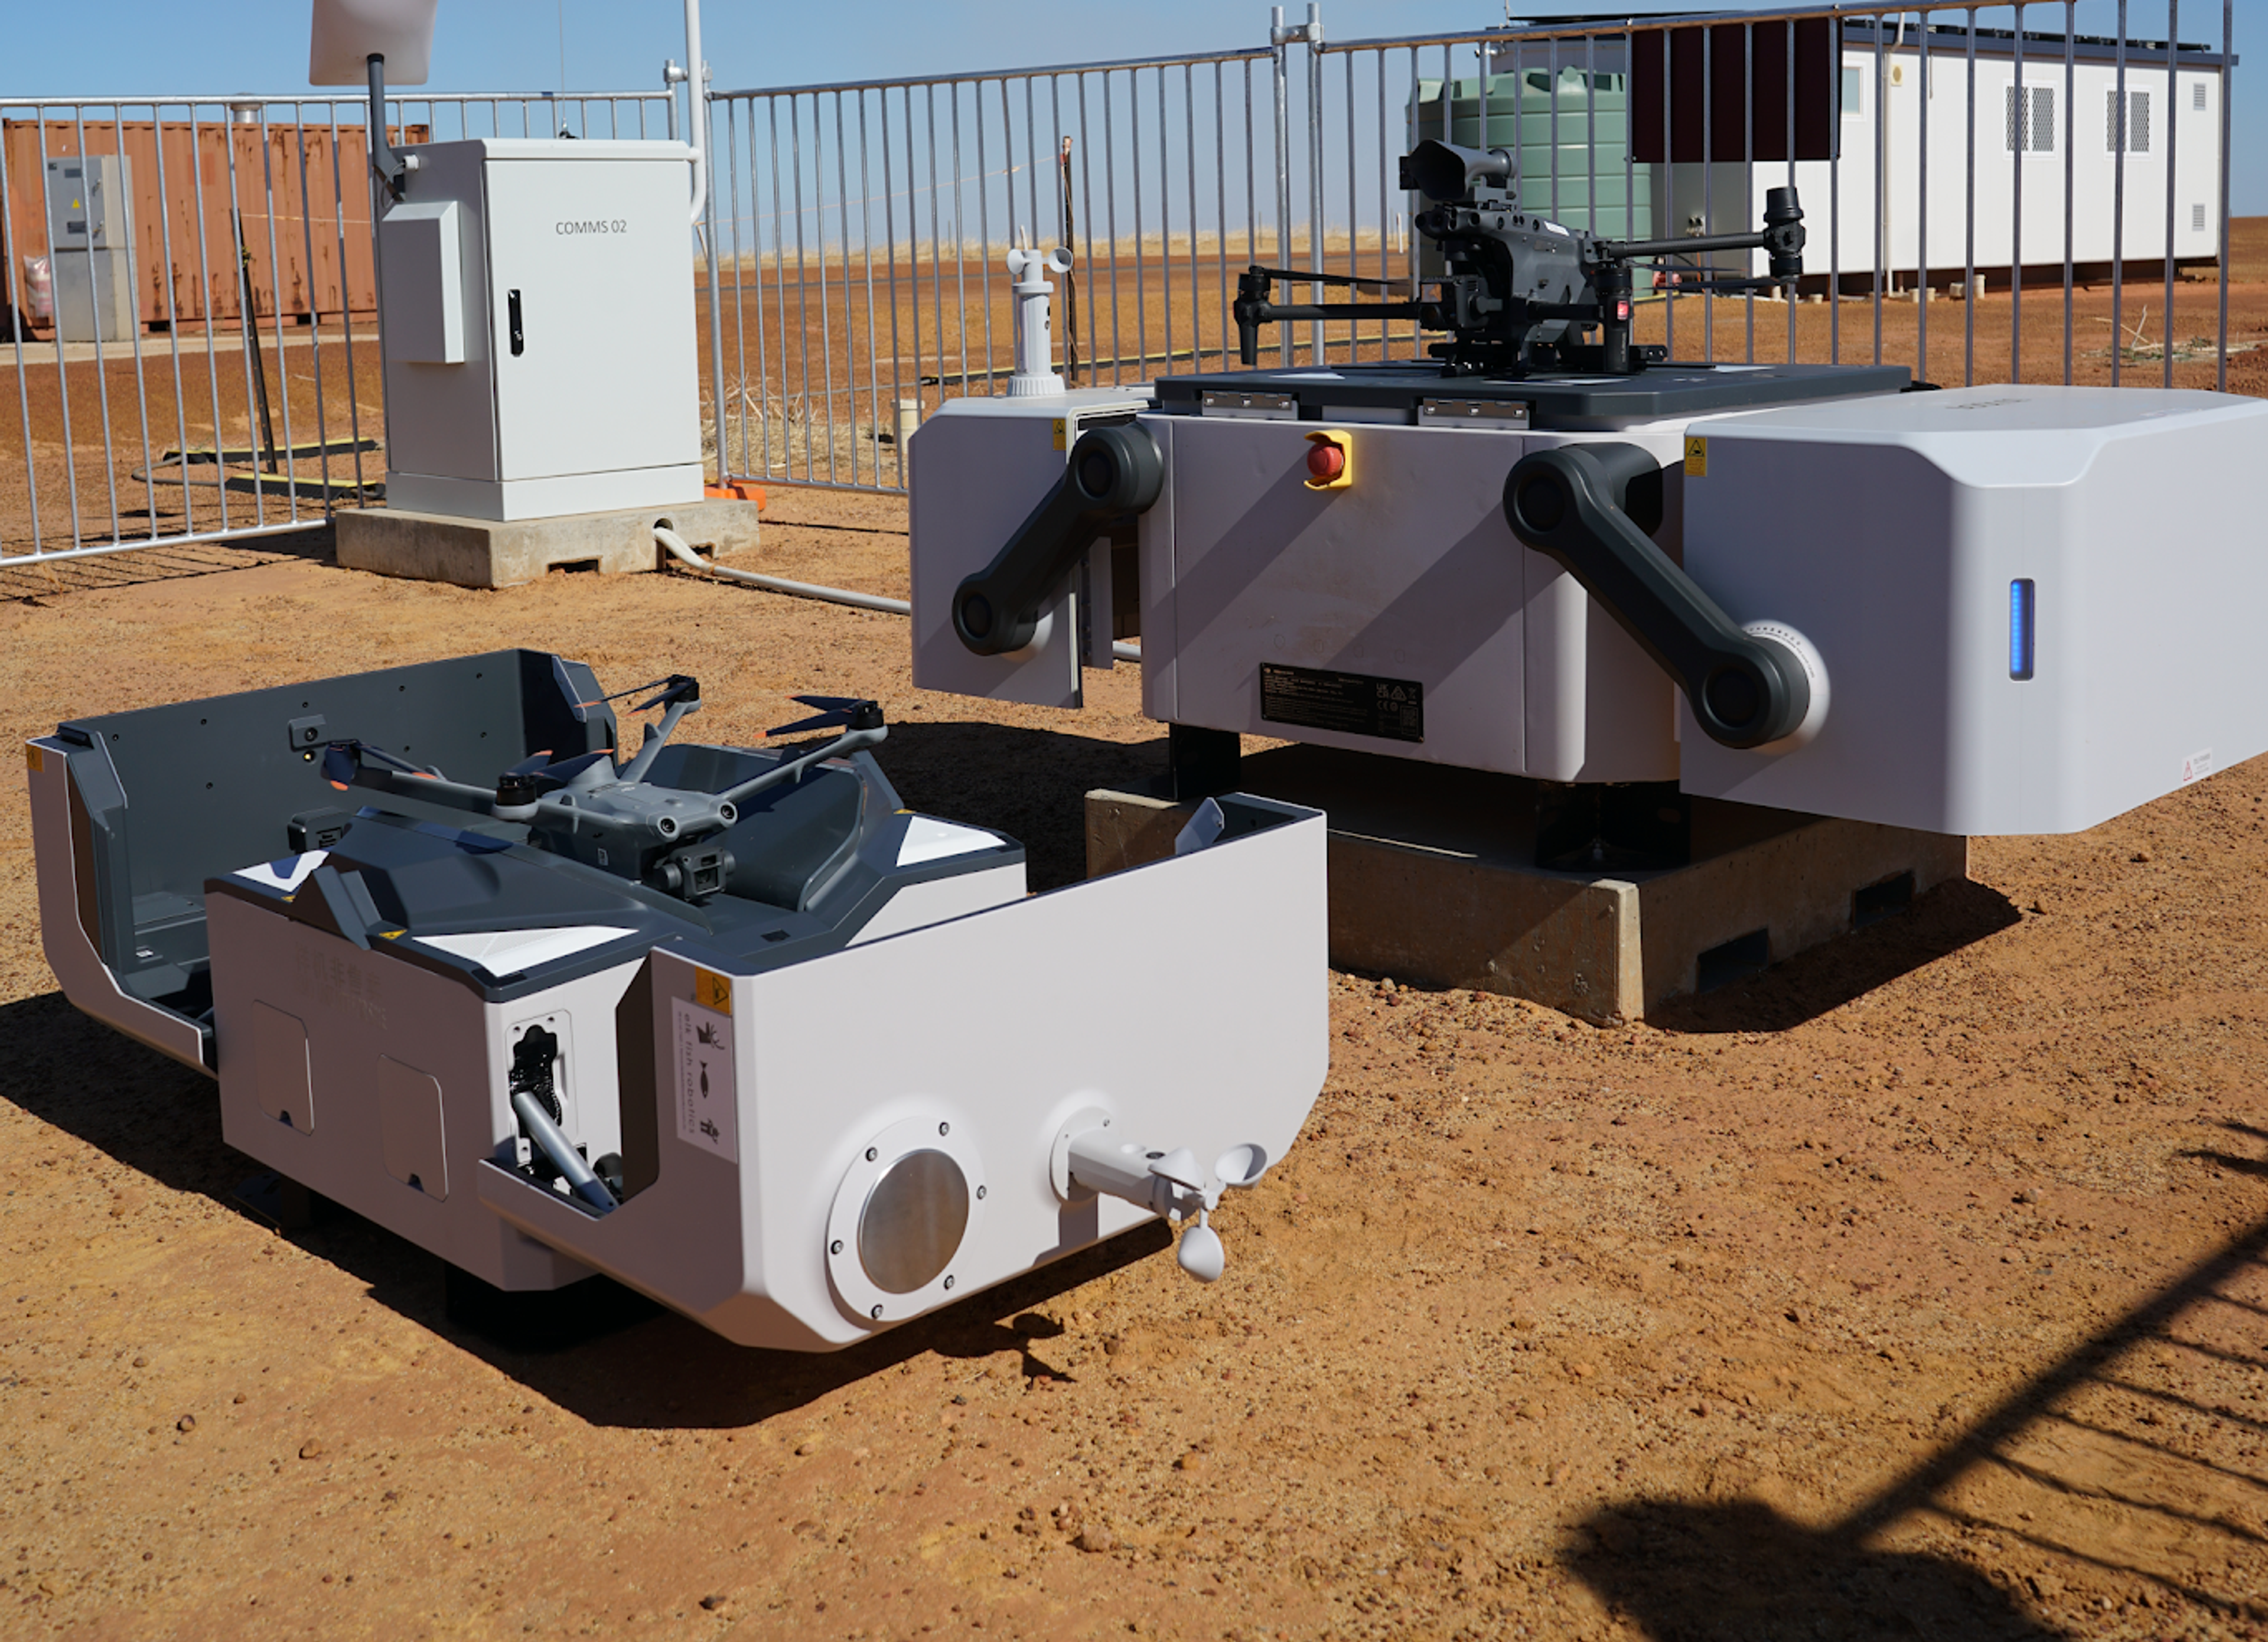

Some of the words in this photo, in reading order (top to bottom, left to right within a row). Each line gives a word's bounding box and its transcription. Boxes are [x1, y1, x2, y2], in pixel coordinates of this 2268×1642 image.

[556, 220, 608, 234] COMMS
[611, 220, 627, 233] 02
[687, 1073, 695, 1133] robotics
